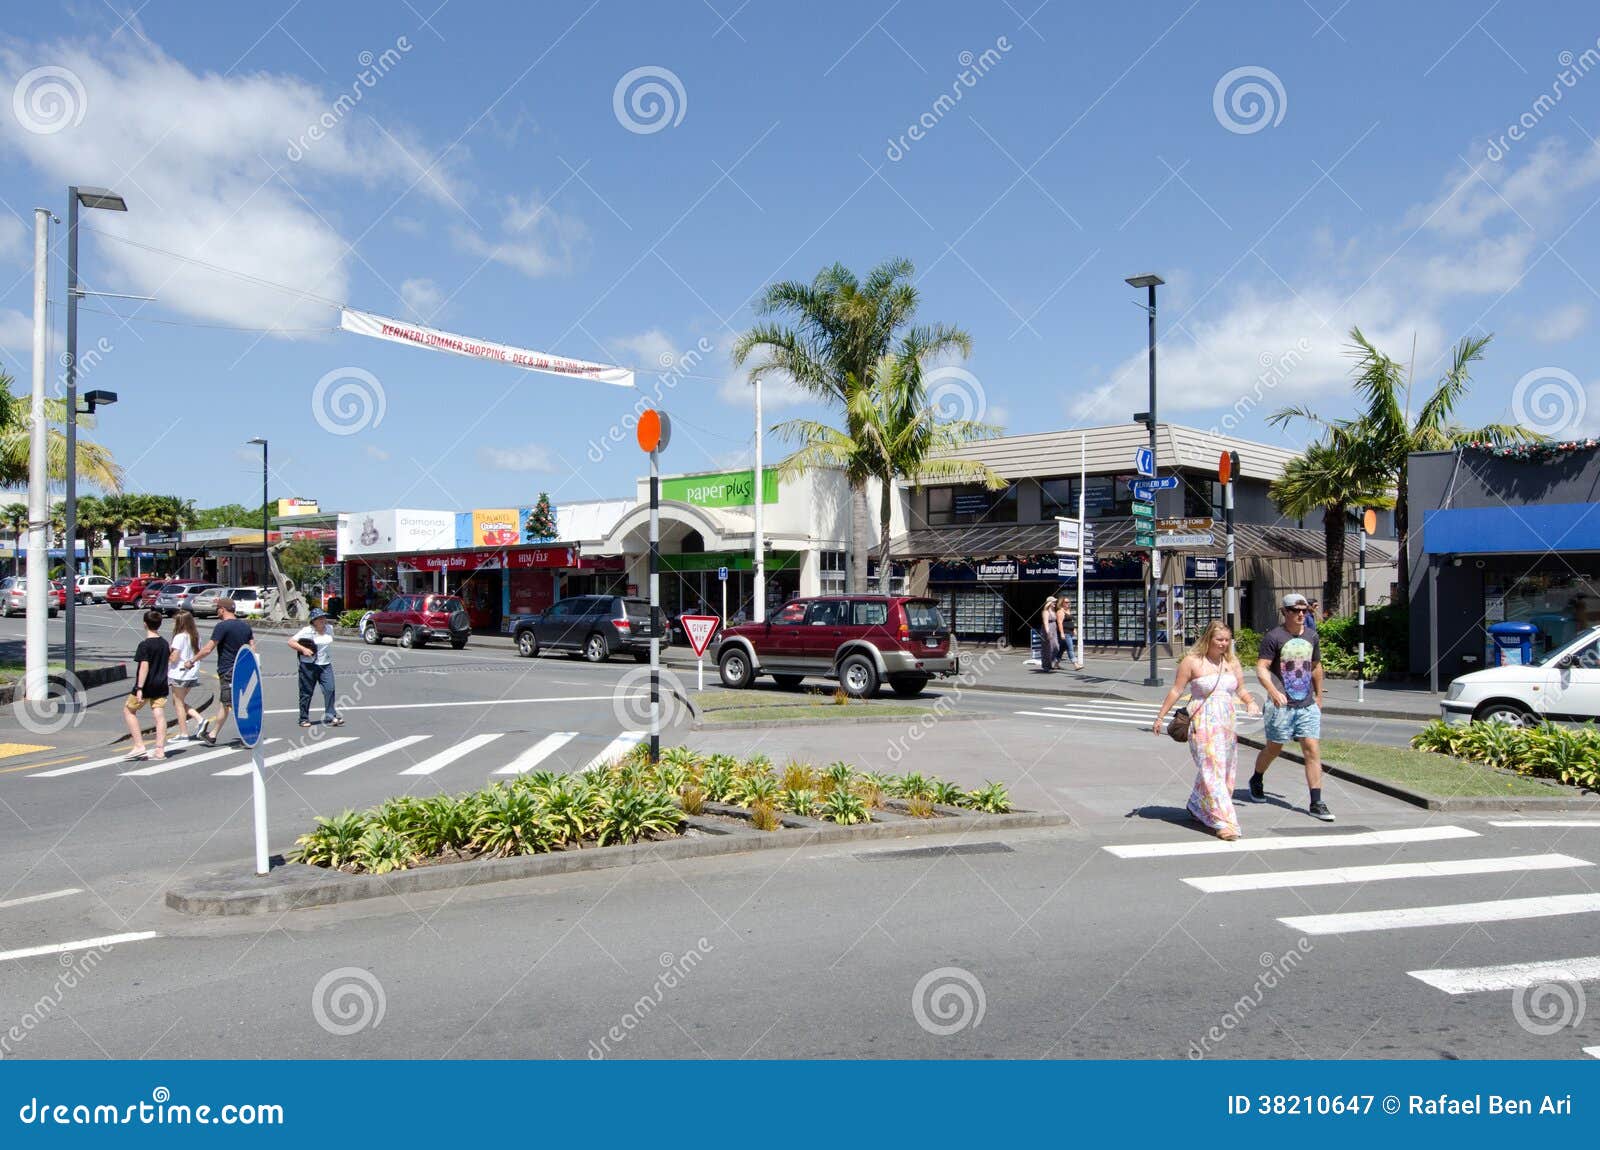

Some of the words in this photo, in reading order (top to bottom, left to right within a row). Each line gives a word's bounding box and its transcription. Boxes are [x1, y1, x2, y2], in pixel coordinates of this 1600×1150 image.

[382, 324, 424, 342] KERIKERI
[426, 334, 462, 351] SUMMER
[464, 343, 505, 360] SHOPPING
[512, 353, 528, 365] DEC
[534, 359, 549, 369] JAN
[687, 485, 726, 503] paper
[726, 478, 751, 501] plus
[409, 527, 436, 536] direct
[450, 557, 467, 567] Dairy
[980, 563, 1016, 574] Harcourts
[692, 623, 709, 633] GIVE
